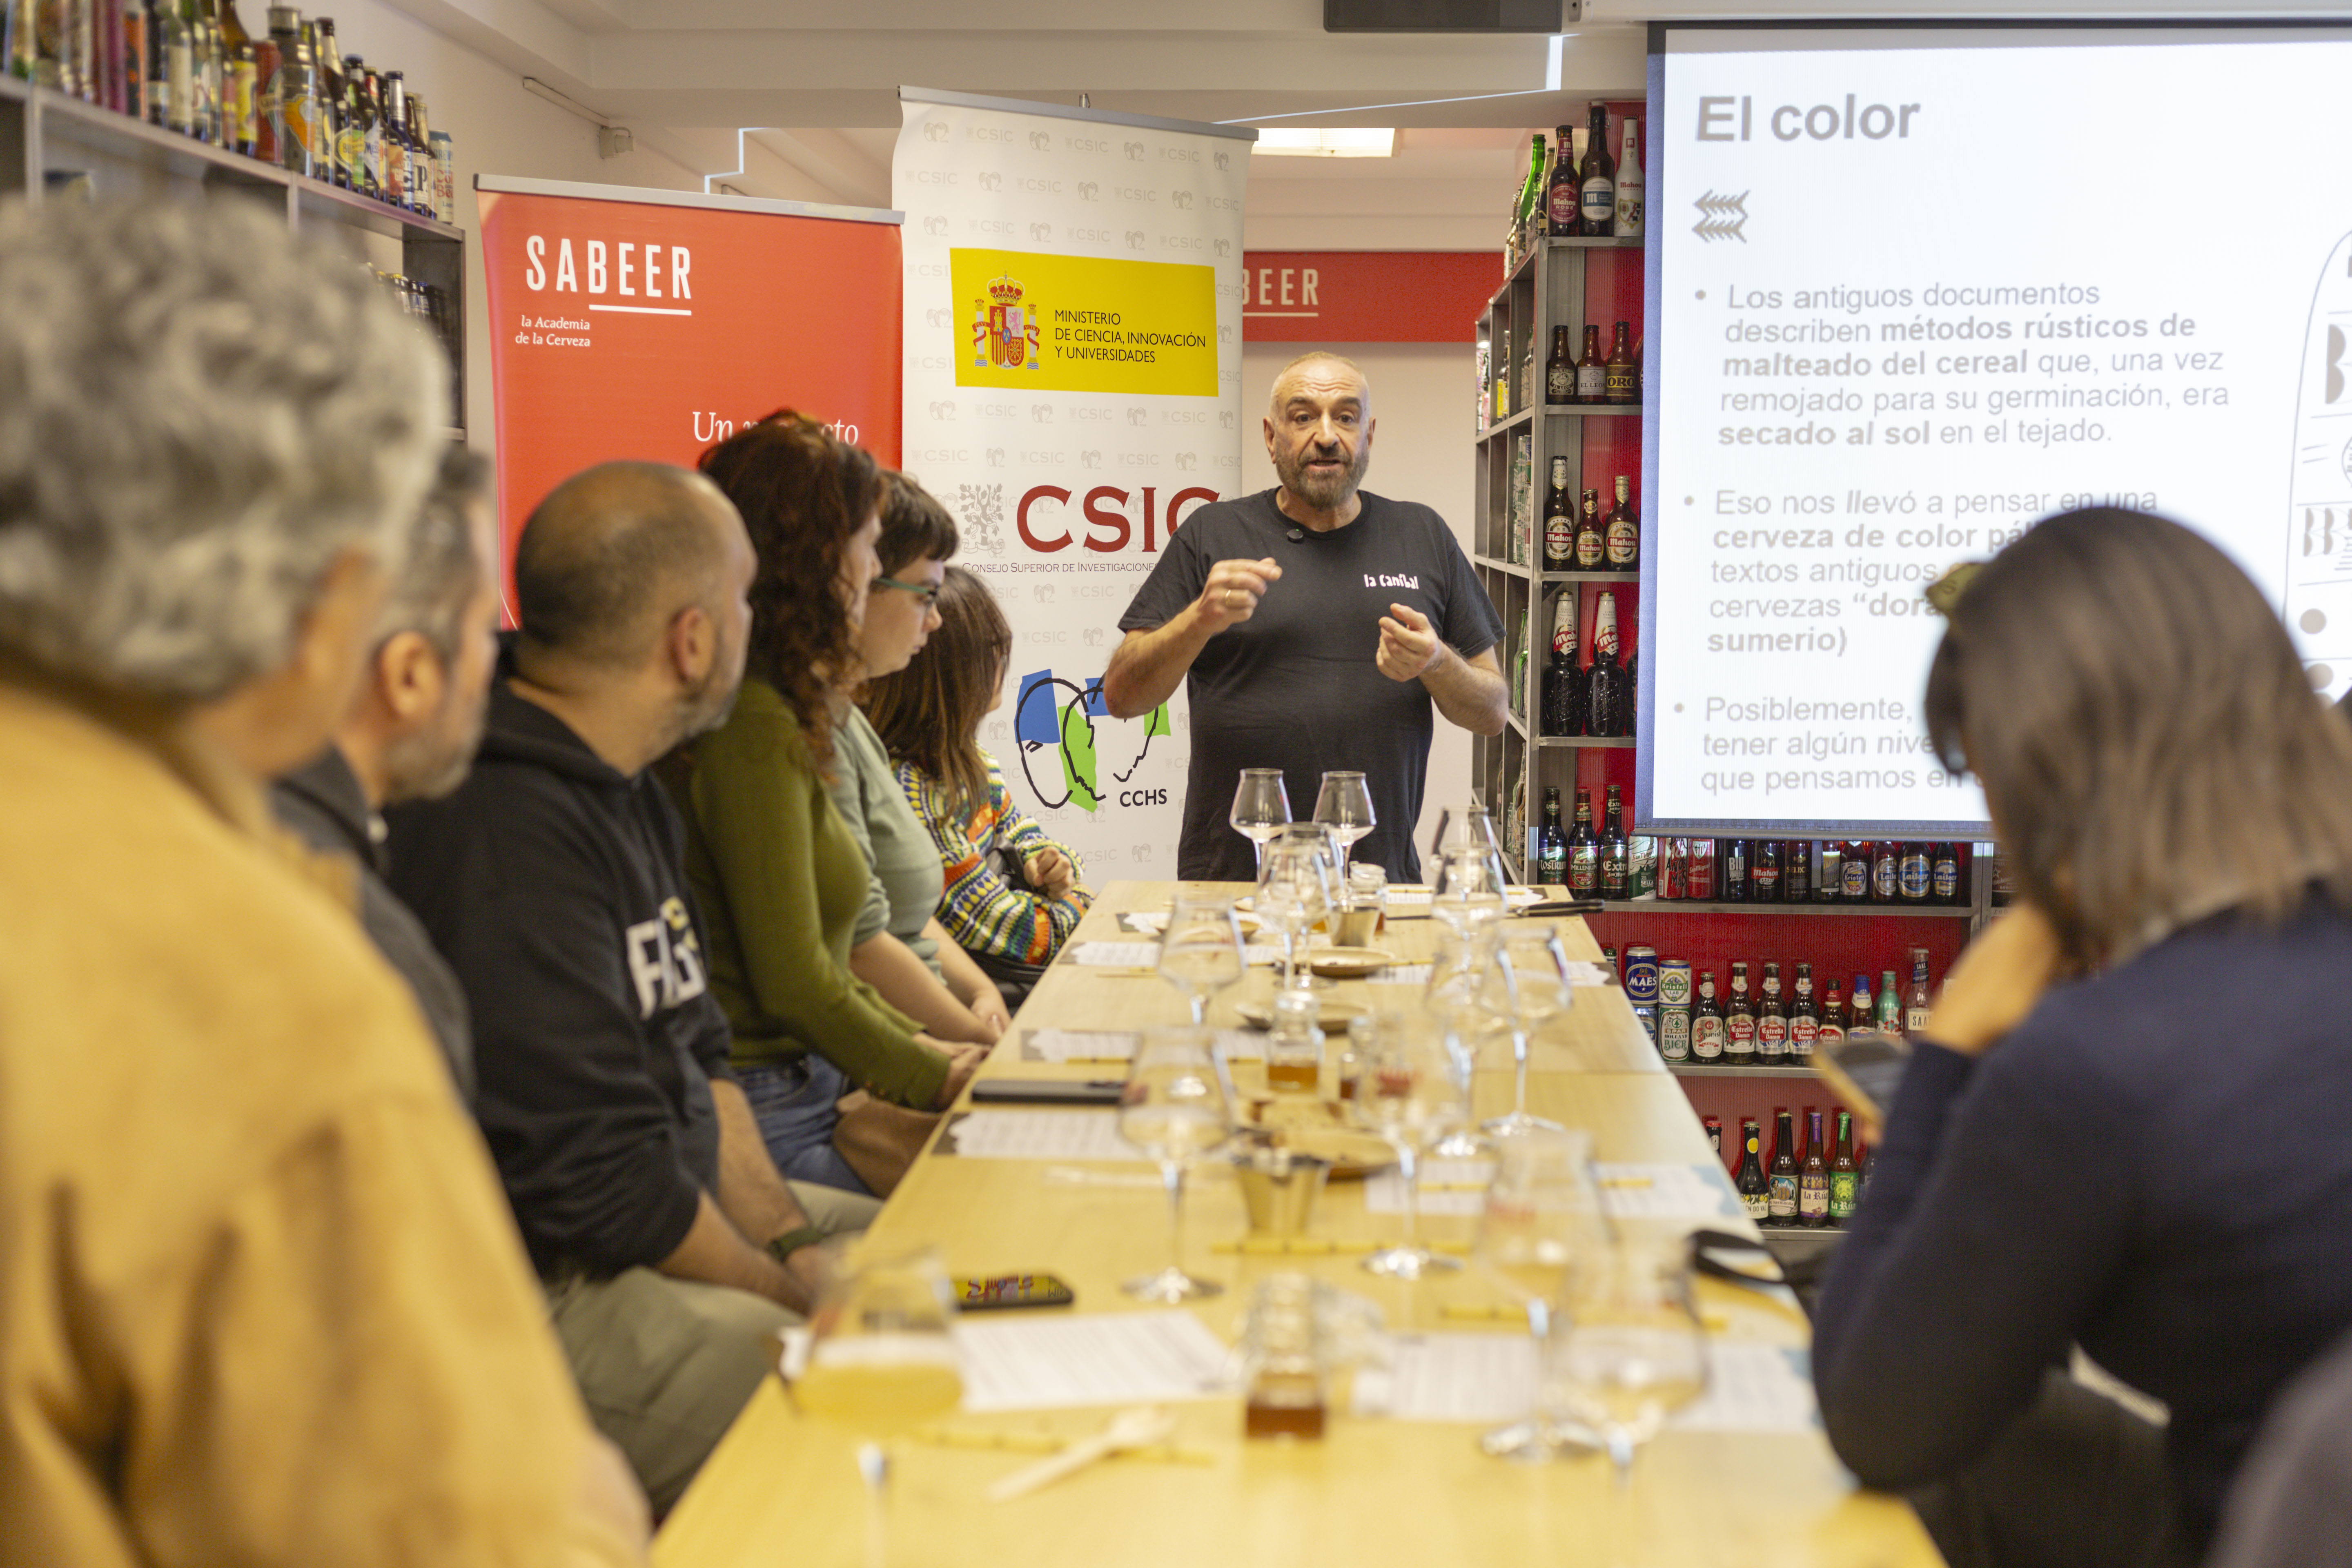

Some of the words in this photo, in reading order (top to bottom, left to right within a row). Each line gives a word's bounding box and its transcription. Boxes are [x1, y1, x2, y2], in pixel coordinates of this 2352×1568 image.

[1696, 95, 1752, 142] El
[1771, 94, 1921, 141] color
[526, 235, 692, 299] SABEER
[918, 265, 949, 276] CSI
[1728, 284, 1782, 309] Los
[1793, 284, 1913, 315] antiguos
[1923, 282, 2100, 307] documentos
[521, 315, 532, 327] la
[535, 317, 590, 330] Academia
[1055, 310, 1120, 325] MINISTERIO
[1725, 318, 1871, 343] describen
[1881, 314, 2012, 342] métodos
[2024, 312, 2148, 339] rústicos
[2159, 312, 2196, 337] de
[515, 332, 529, 344] de
[532, 332, 543, 345] la
[546, 334, 590, 347] Cerveza
[1055, 328, 1071, 341] DE
[1074, 329, 1125, 345] CIENCIA,
[1127, 332, 1206, 347] INNOVACIÓN
[922, 357, 952, 369] CSI
[1055, 346, 1062, 358] Y
[1067, 347, 1156, 363] UNIVERSIDADES
[1723, 352, 1872, 376] malteado
[1882, 350, 1925, 376] del
[1936, 348, 2027, 374] cereal
[2038, 354, 2098, 379] que,
[2112, 353, 2163, 372] una
[2174, 352, 2223, 370] vez
[1721, 388, 1863, 418] remojado
[1874, 392, 1934, 417] para
[1946, 391, 1977, 410] su
[1987, 383, 2170, 416] germinación,
[2183, 387, 2228, 406] era
[693, 412, 733, 442] Un
[1718, 421, 1836, 445] secado
[1846, 421, 1874, 445] al
[1885, 420, 1929, 445] sol
[1940, 425, 1972, 444] en
[1984, 419, 2007, 443] el
[2018, 418, 2111, 448] tejado.
[1716, 490, 1771, 515] Eso
[1783, 495, 1835, 514] nos
[1846, 489, 1917, 514] llevó
[1927, 495, 1942, 514] a
[1955, 494, 2050, 519] pensar
[2061, 492, 2093, 512] en
[2105, 491, 2158, 511] una
[1548, 533, 1572, 541] Mahou
[1610, 538, 1636, 546] Mahou
[1713, 529, 1833, 549] cerveza
[1844, 523, 1885, 548] de
[1896, 523, 1978, 548] color
[1011, 562, 1059, 572] SUPERIOR
[1062, 563, 1075, 572] DE
[1711, 561, 1799, 583] textos
[1809, 557, 1938, 588] antiguos
[1364, 574, 1376, 588] la
[1710, 599, 1841, 618] cervezas
[1708, 626, 1847, 657] sumerio)
[1706, 695, 1912, 724] Posiblemente,
[1704, 734, 1777, 756] tener
[1786, 730, 1866, 762] algún
[1701, 771, 1755, 796] que
[1766, 770, 1916, 796] pensamos
[1119, 788, 1167, 807] CCHS
[1629, 976, 1657, 986] MAES
[1695, 1027, 1722, 1043] Spanish
[1664, 1040, 1687, 1051] BIER
[1804, 1191, 1811, 1200] la
